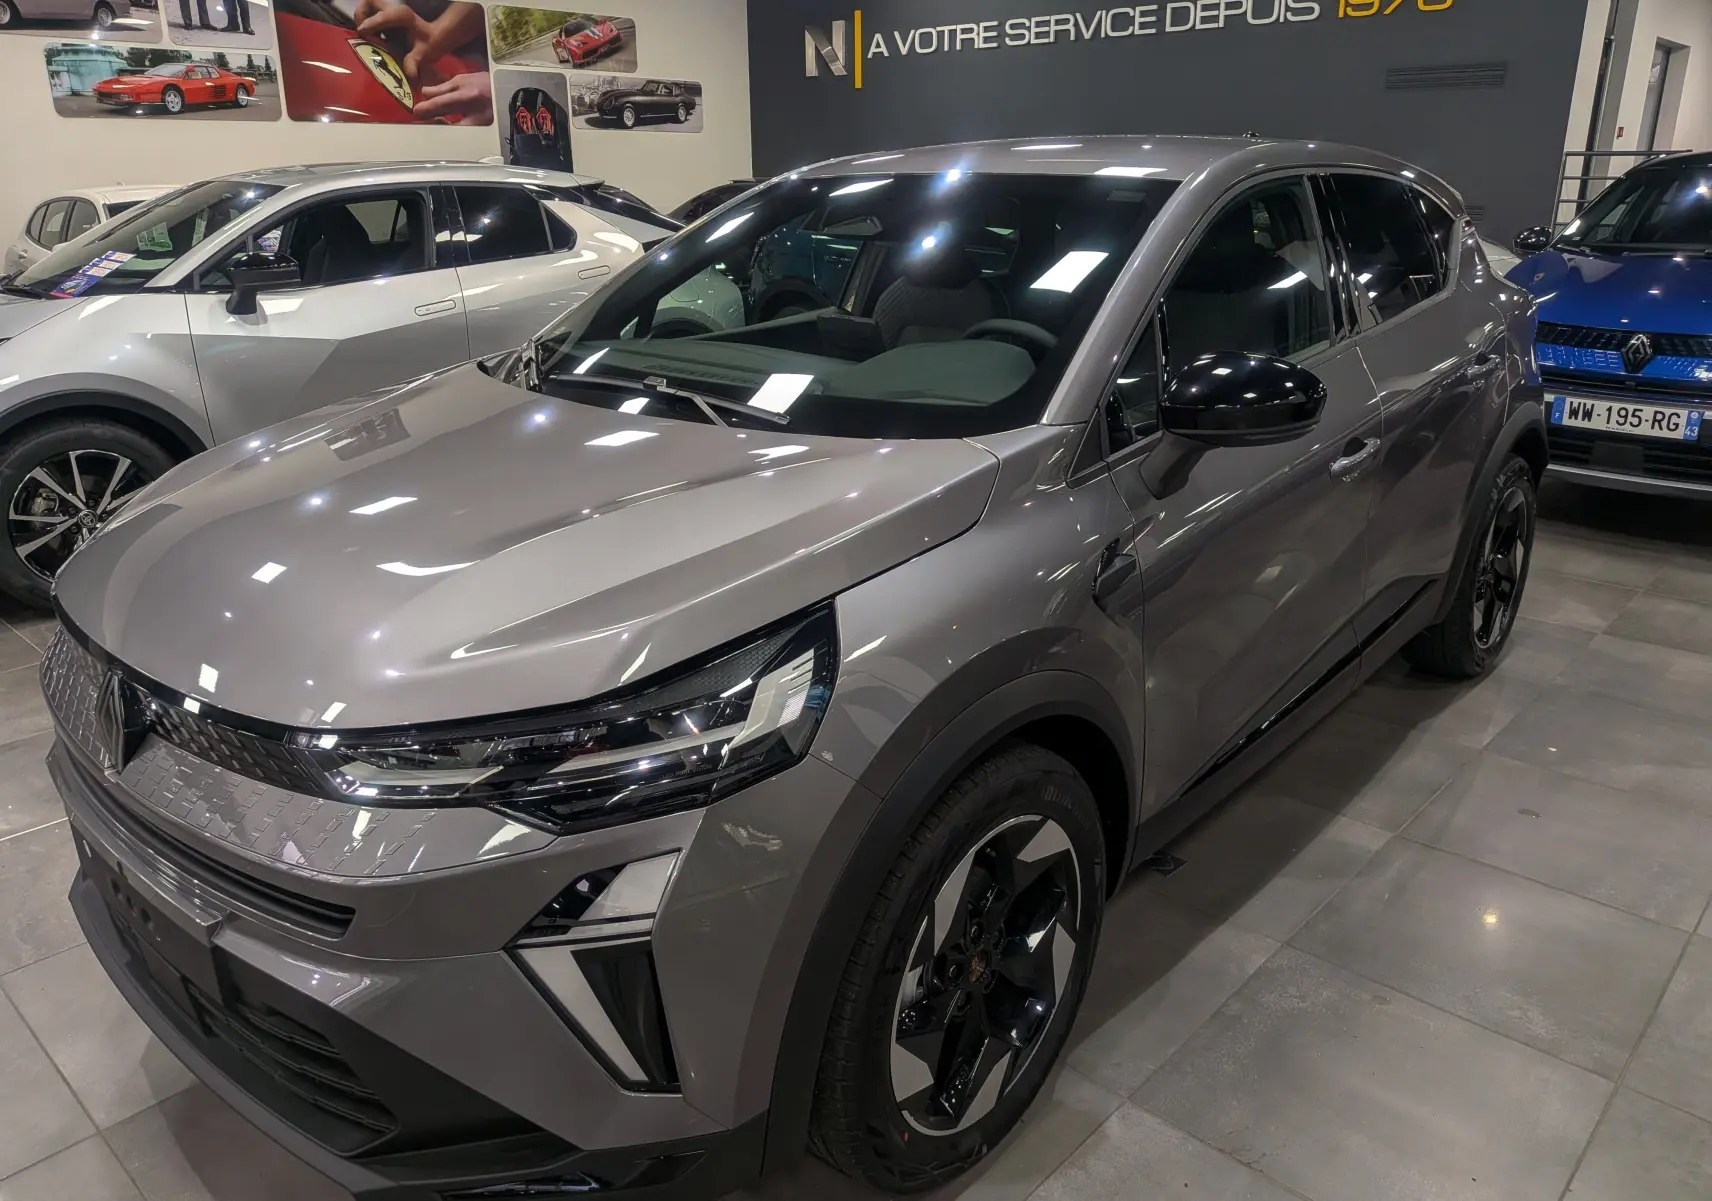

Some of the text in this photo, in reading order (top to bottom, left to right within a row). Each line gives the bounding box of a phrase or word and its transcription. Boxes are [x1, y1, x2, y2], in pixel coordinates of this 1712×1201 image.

[804, 20, 848, 77] N
[867, 33, 889, 59] A
[894, 20, 999, 55] VOTRE
[1005, 4, 1157, 46] SERVICE
[1165, 0, 1321, 32] DEPUIS
[1568, 401, 1681, 432] WW-195-RG
[1684, 426, 1698, 437] 43
